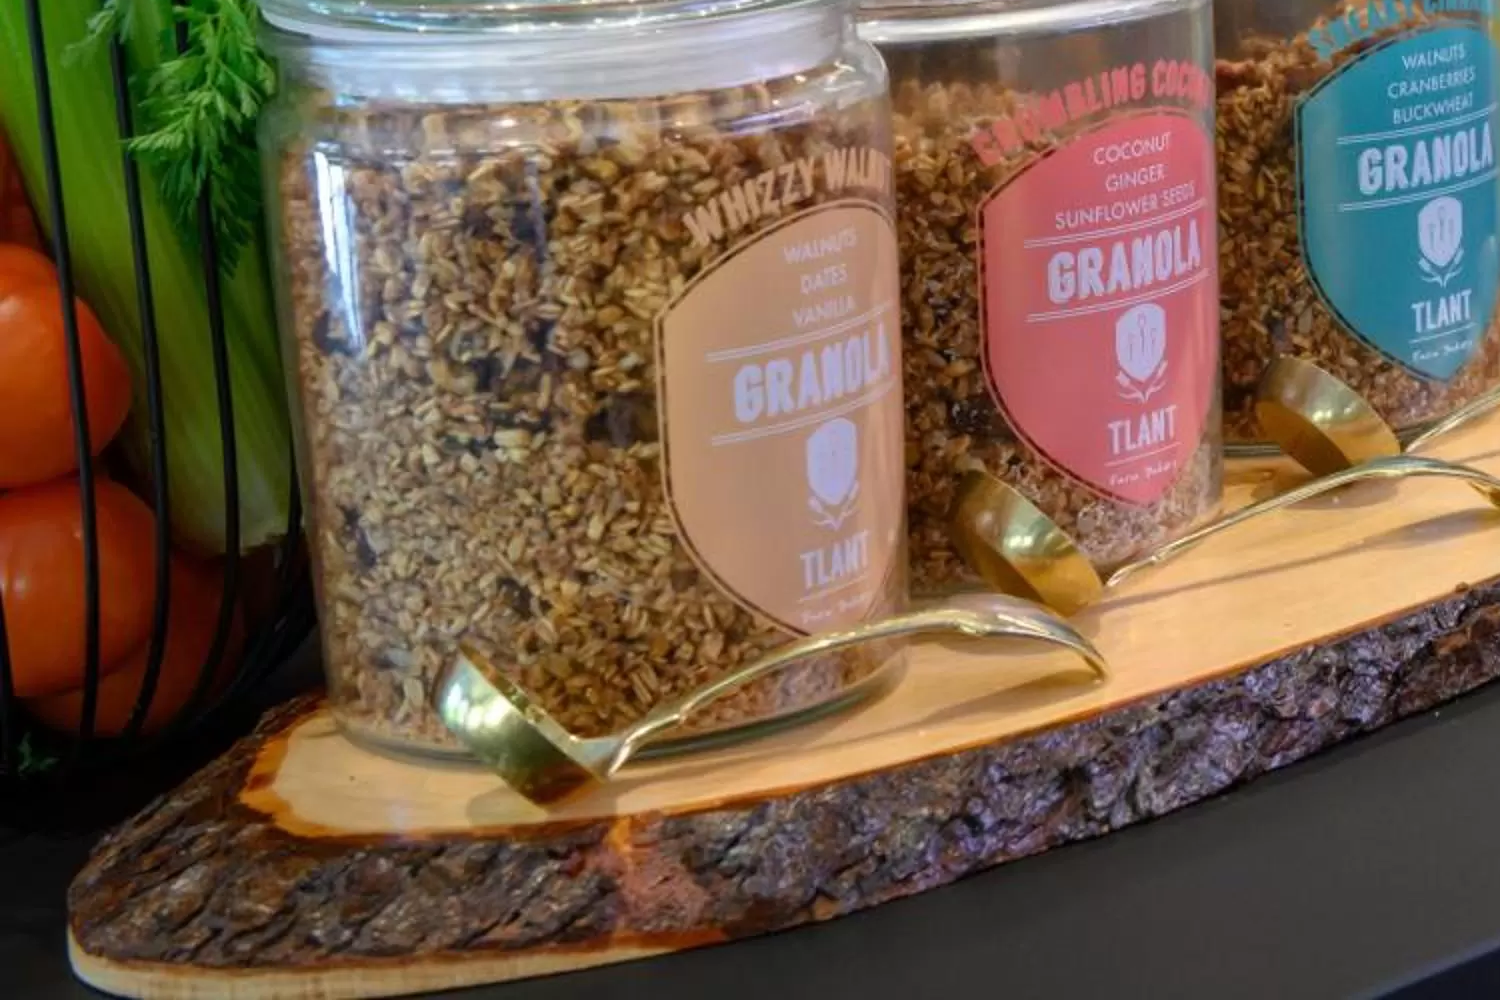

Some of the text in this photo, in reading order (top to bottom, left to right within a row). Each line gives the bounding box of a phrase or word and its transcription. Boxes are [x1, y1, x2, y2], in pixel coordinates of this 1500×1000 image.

[1401, 42, 1466, 71] WALNUTS
[1387, 65, 1476, 100] CRANBERRIES
[1393, 91, 1474, 125] BUCKWHEAT
[1092, 131, 1171, 166] COCONUT
[1357, 121, 1494, 196] GRANOLA
[1105, 163, 1167, 193] GINGER
[681, 156, 815, 250] WHIZZY
[1054, 180, 1196, 231] SUNFLOWER SEEDS
[783, 225, 858, 265] WALNUTS
[1047, 218, 1201, 305] GRANOLA
[792, 295, 856, 328] VANILLA
[1410, 287, 1473, 334] TLANT
[732, 322, 891, 425] GRANOLA
[1107, 404, 1177, 456] TLANT
[799, 529, 871, 590] TLANT
